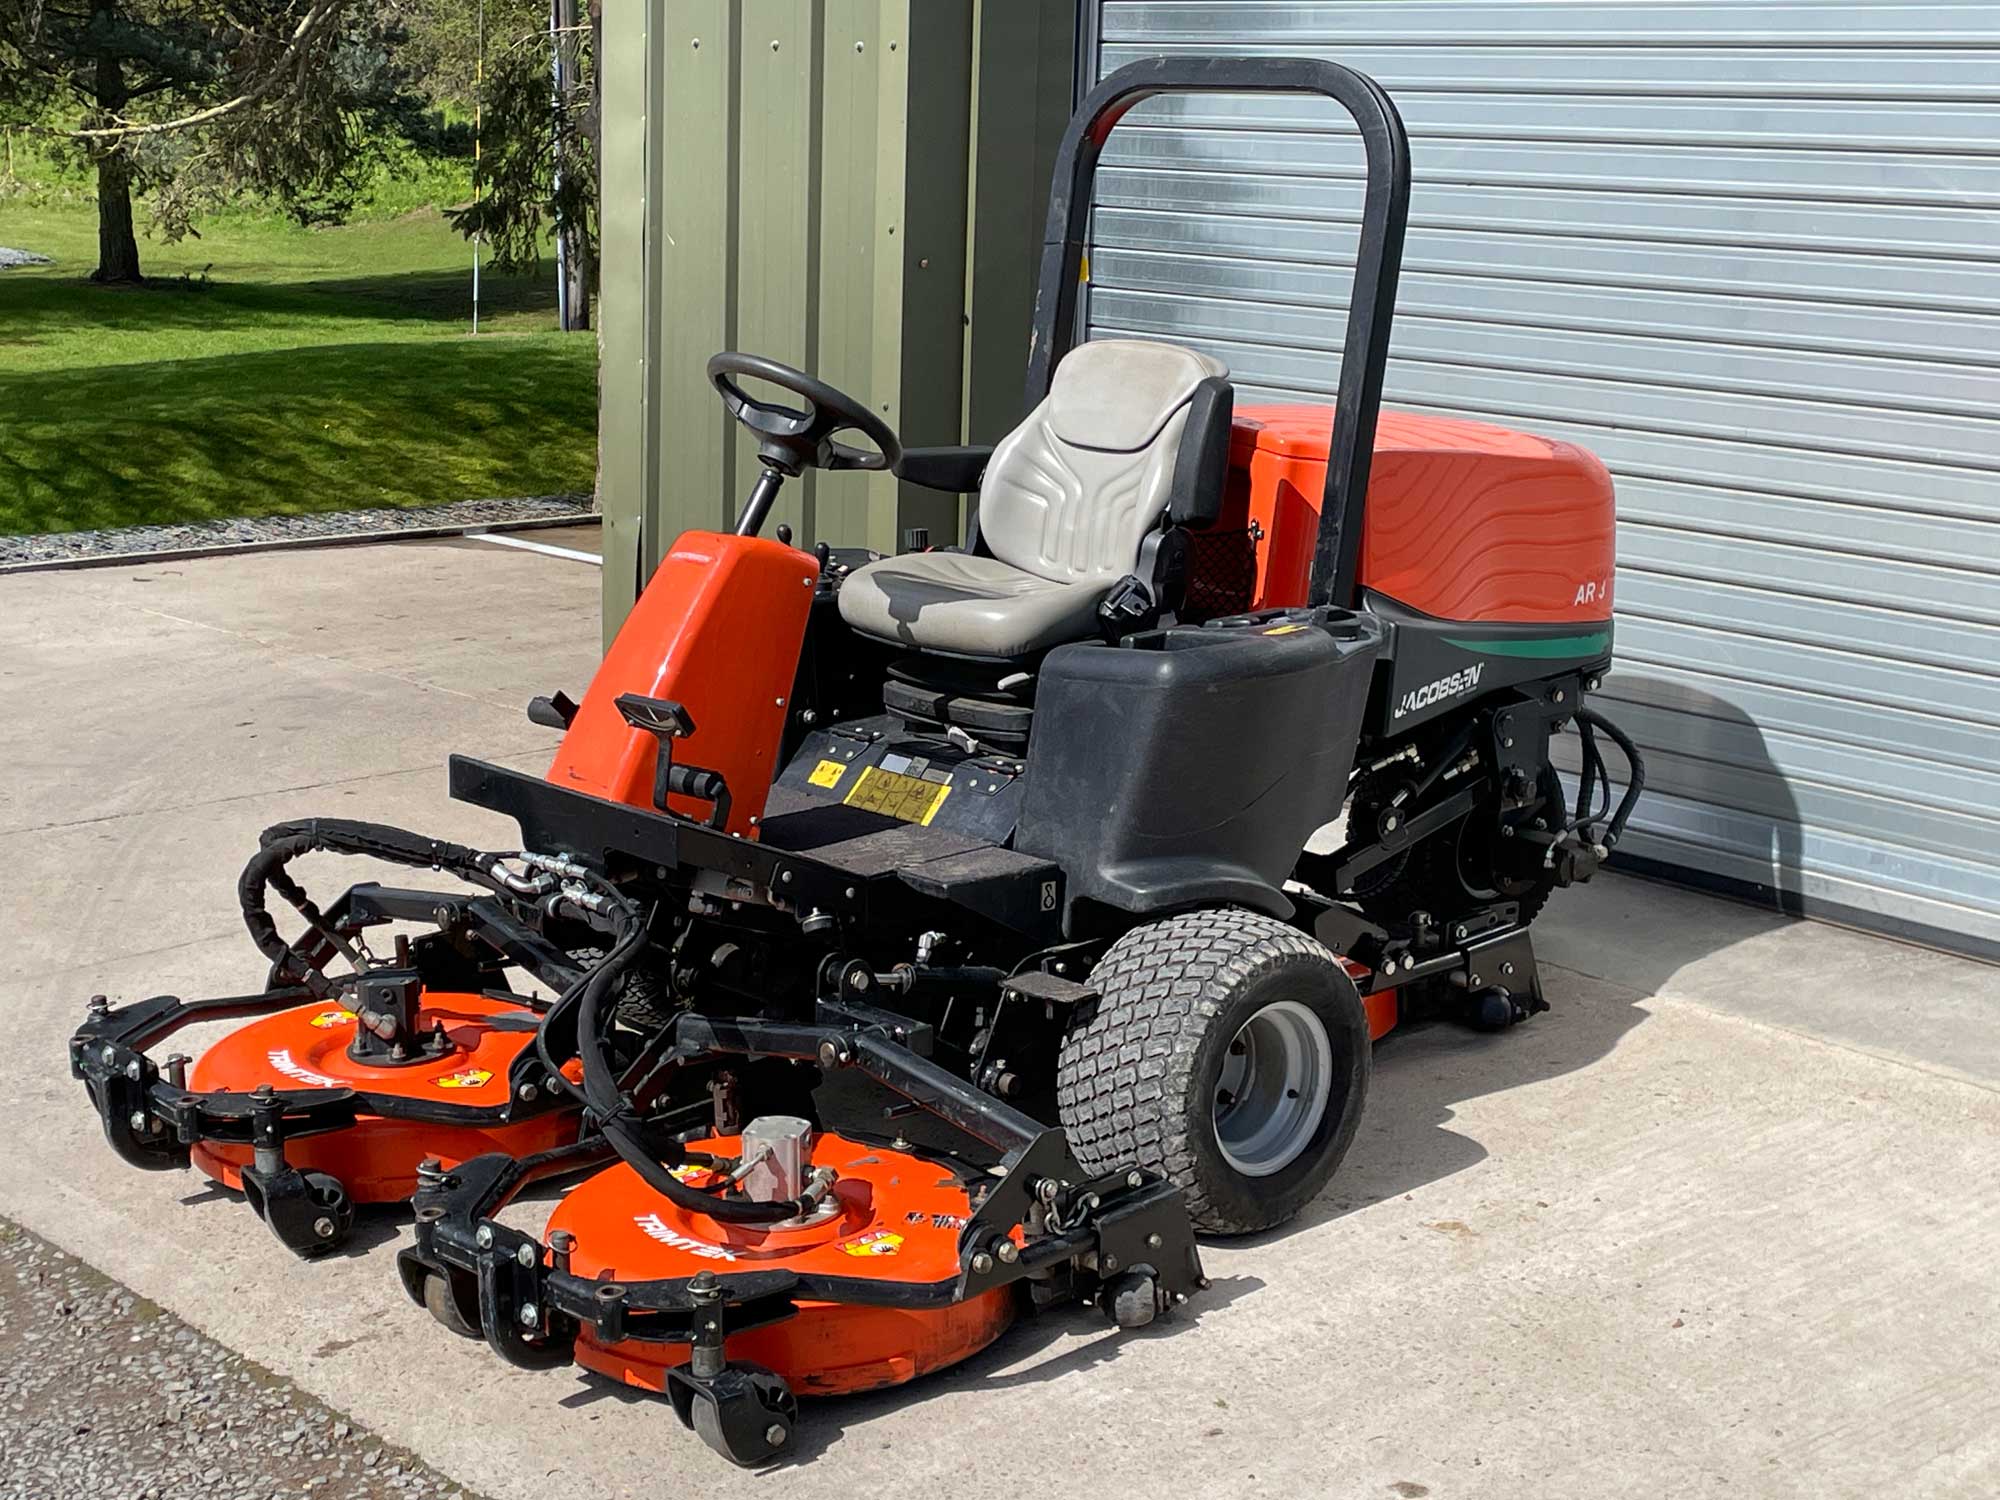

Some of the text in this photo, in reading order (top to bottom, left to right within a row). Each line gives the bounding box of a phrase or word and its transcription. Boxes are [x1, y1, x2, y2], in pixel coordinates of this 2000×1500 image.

[1573, 581, 1596, 607] AR
[1394, 662, 1483, 719] JACOBSEN
[267, 1049, 353, 1088] TRIMTEK
[633, 1213, 747, 1262] TRIMTEK
